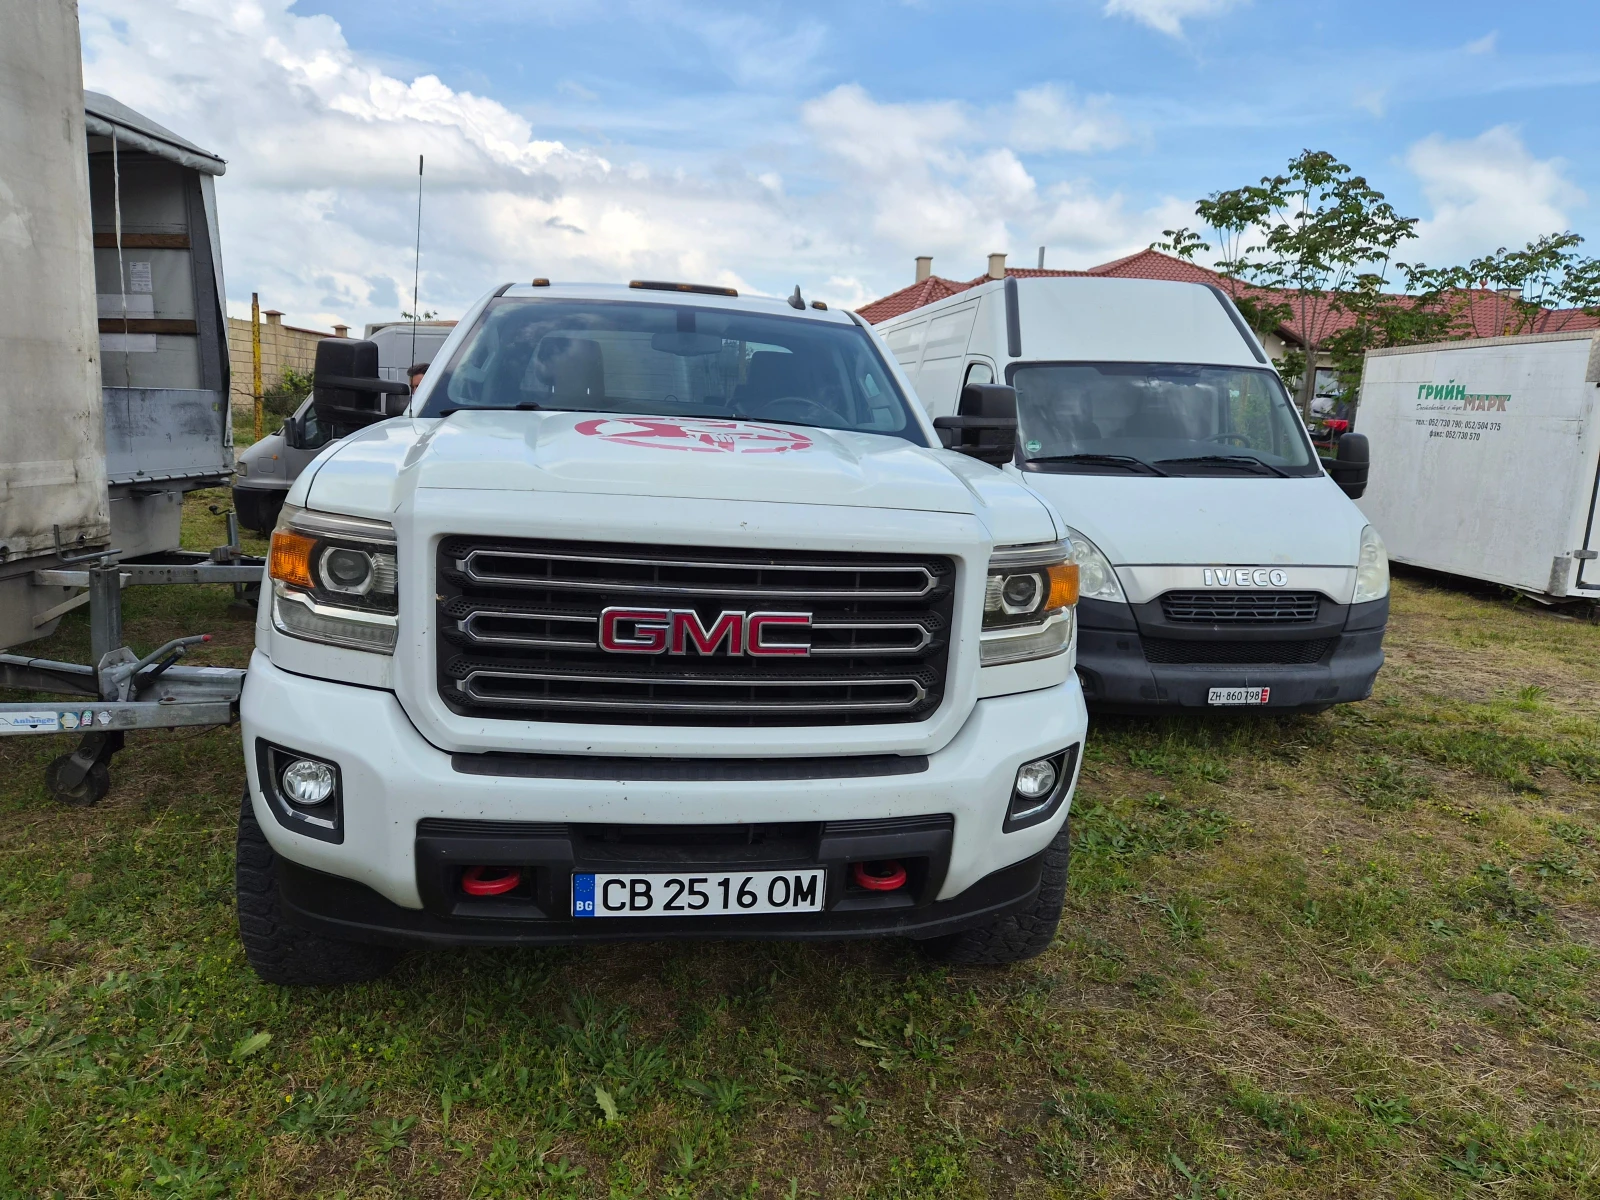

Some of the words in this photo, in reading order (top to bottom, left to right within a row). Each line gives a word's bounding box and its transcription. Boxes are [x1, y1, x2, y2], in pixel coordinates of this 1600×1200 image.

[1417, 379, 1466, 400] ГРИЙН
[1463, 395, 1507, 411] МАРК
[1428, 418, 1451, 428] 052/730
[1489, 422, 1502, 432] 375
[1469, 432, 1481, 441] 570
[1204, 569, 1288, 586] IVECO
[600, 606, 813, 657] GMC
[602, 879, 654, 912] CB
[663, 877, 758, 911] 2516
[767, 875, 818, 907] OM
[576, 901, 593, 911] BG
